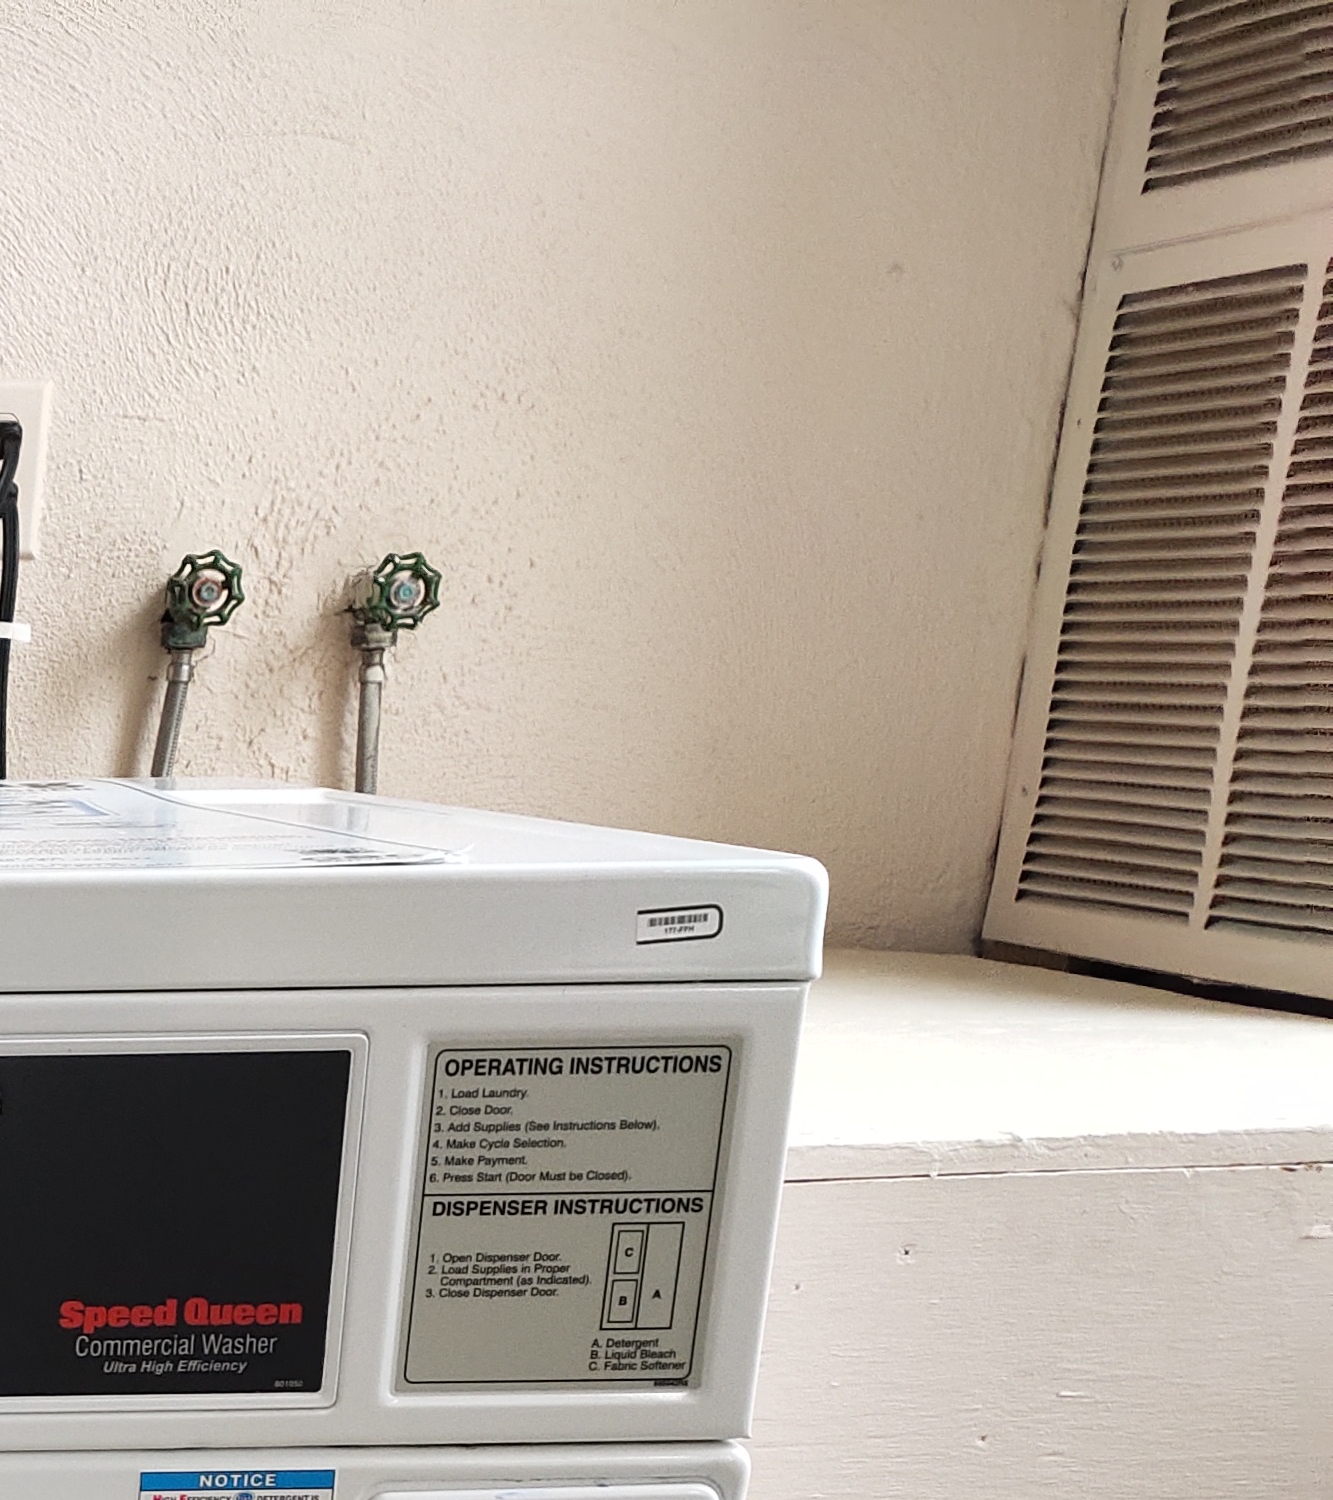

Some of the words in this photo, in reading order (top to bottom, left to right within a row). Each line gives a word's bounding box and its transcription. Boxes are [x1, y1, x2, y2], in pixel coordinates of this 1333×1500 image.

[444, 1056, 563, 1076] OPERATING
[569, 1054, 722, 1074] INSTRUCTIONS
[451, 1087, 479, 1098] Load
[449, 1104, 481, 1115] Close
[446, 1121, 470, 1132] Add
[473, 1121, 521, 1133] Supplies
[524, 1120, 550, 1133] (See
[552, 1120, 616, 1131] Instructions
[445, 1138, 476, 1149] Make
[478, 1138, 510, 1151] Cycle
[444, 1155, 474, 1165] Make
[442, 1172, 473, 1182] Press
[476, 1171, 502, 1182] Start
[505, 1171, 536, 1183] (Door
[538, 1170, 566, 1181] Must
[568, 1170, 583, 1181] be
[431, 1199, 547, 1216] DISPENSER
[553, 1196, 703, 1214] INSTRUCTIONS
[442, 1252, 472, 1264] Open
[475, 1252, 530, 1264] Dispenser
[624, 1247, 634, 1257] C
[441, 1264, 469, 1274] Load
[471, 1263, 518, 1275] Supplies
[520, 1263, 530, 1273] in
[533, 1263, 570, 1275] Proper
[439, 1275, 513, 1287] Compartment
[516, 1275, 533, 1287] (as
[438, 1287, 470, 1297] Close
[472, 1287, 528, 1299] Dispenser
[651, 1289, 661, 1299] A
[617, 1295, 627, 1305] B
[58, 1298, 177, 1334] Speed
[183, 1297, 302, 1325] Queen
[75, 1334, 194, 1356] Commercial
[201, 1333, 277, 1354] Washer
[605, 1337, 659, 1349] Detergent
[604, 1348, 639, 1360] Liquid
[639, 1348, 676, 1359] Bleach
[103, 1360, 136, 1372] Ultra
[139, 1360, 173, 1374] High
[176, 1359, 247, 1373] Efficiency
[603, 1360, 637, 1371] Fabric
[639, 1359, 686, 1371] Softener
[199, 1473, 276, 1487] NOTICE
